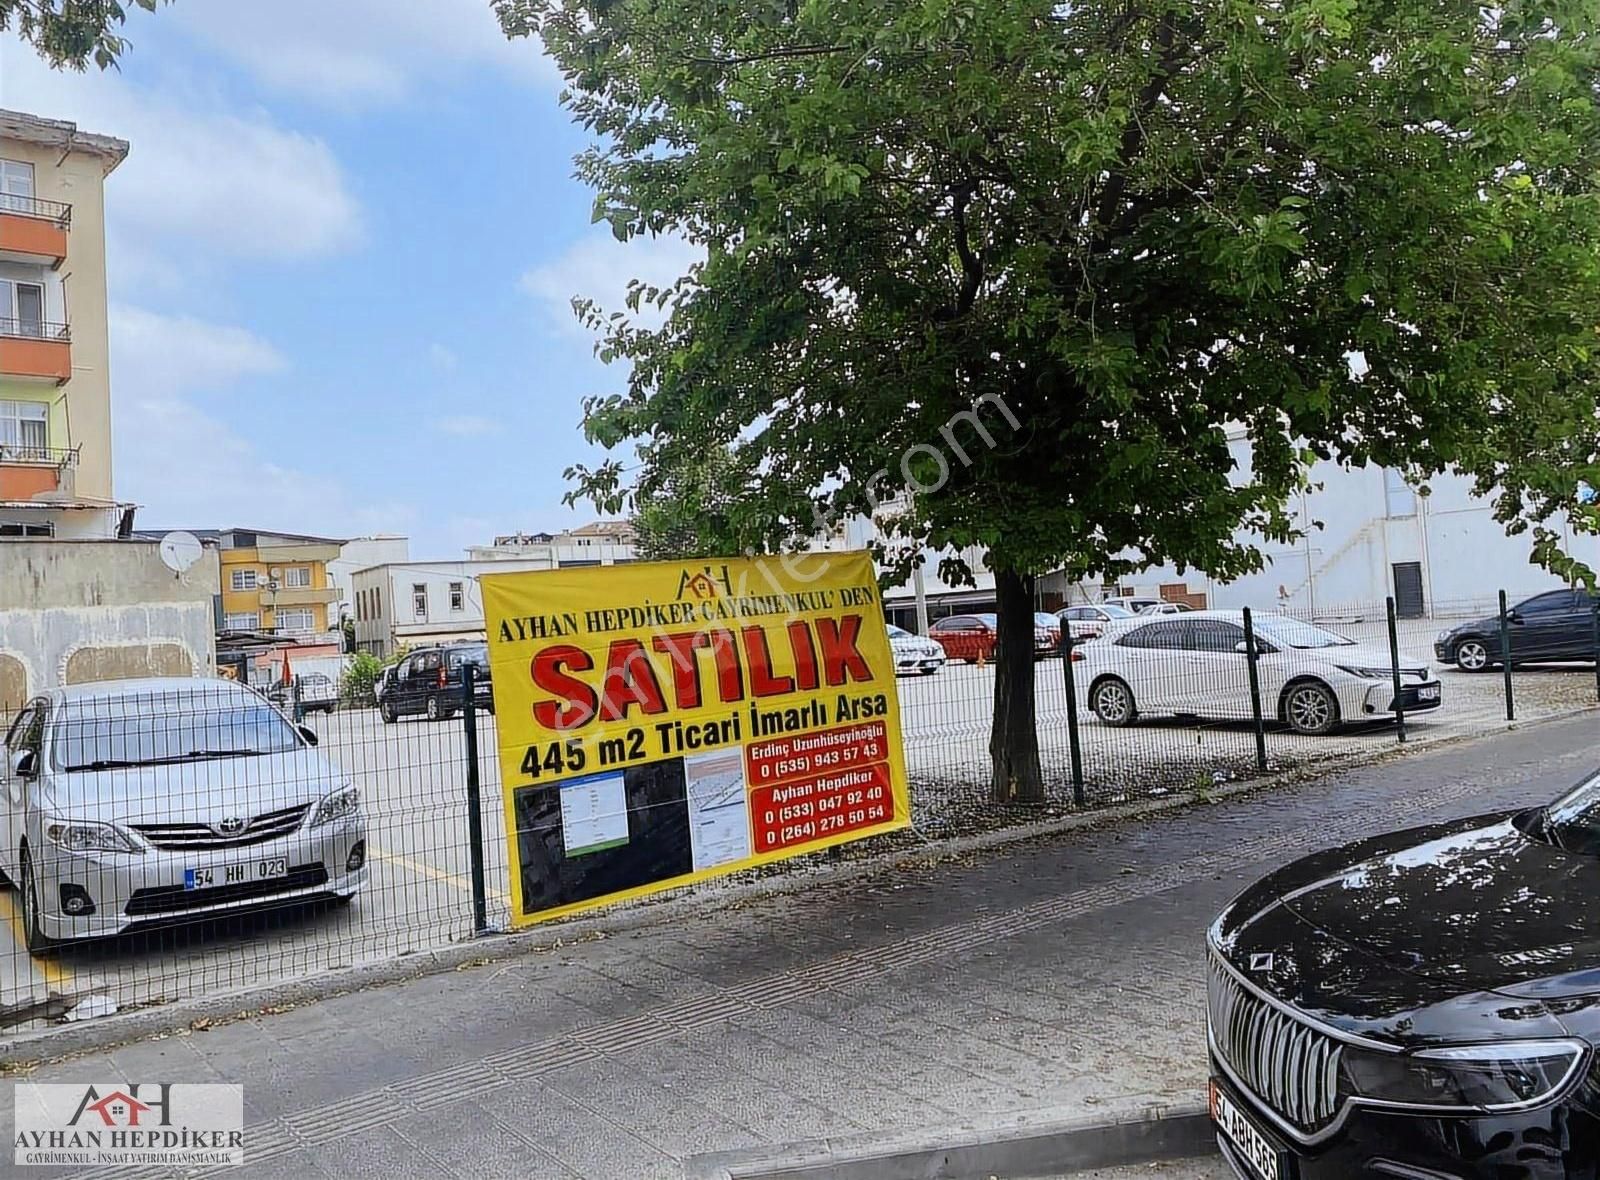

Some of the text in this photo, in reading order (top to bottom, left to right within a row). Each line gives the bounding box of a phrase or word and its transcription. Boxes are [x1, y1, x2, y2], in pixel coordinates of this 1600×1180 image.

[498, 613, 578, 642] AYHAN
[584, 599, 696, 634] HEPDİKER
[840, 586, 875, 607] DEN
[531, 613, 873, 730] SATILIK
[520, 694, 888, 778] 445 m2 Ticari İmarlı Arsa
[752, 725, 883, 760] Erdinç Uzunhüseyinoğlu
[761, 743, 878, 777] 0 (535) 943 57 43
[765, 786, 882, 824] 0 (533) 047 92 40
[772, 771, 873, 804] Ayhan Hepdiker
[767, 805, 883, 844] 0 (264) 278 50 54
[195, 859, 285, 887] 54 HH 023
[1216, 1092, 1228, 1128] 54
[1232, 1110, 1253, 1159] ABH
